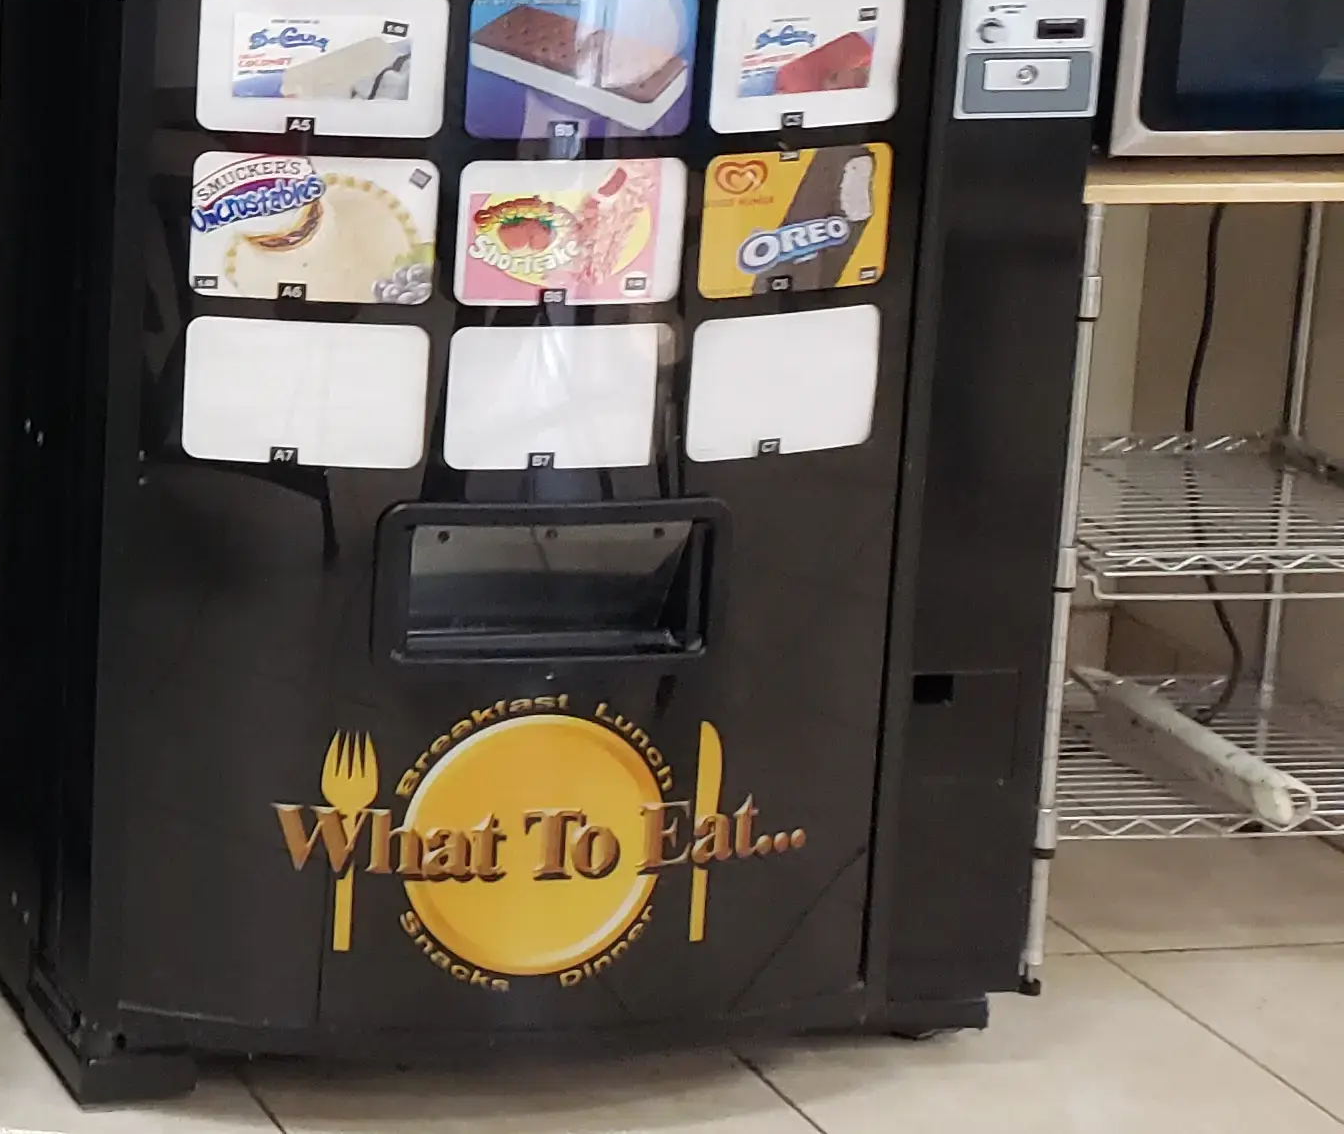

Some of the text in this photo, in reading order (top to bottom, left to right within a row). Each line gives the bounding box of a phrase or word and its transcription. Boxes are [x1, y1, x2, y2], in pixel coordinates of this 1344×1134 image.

[289, 118, 311, 132] A5
[191, 174, 325, 232] Uncrustables
[469, 234, 582, 274] Shortcake
[742, 218, 849, 267] OREO
[274, 449, 295, 463] A7
[531, 453, 552, 467] B7
[759, 439, 779, 454] C7
[395, 692, 571, 798] Breakfast
[594, 702, 674, 792] Lunch
[271, 792, 807, 883] What To Eat...
[398, 909, 511, 993] Snacks
[559, 904, 654, 989] Dinner
